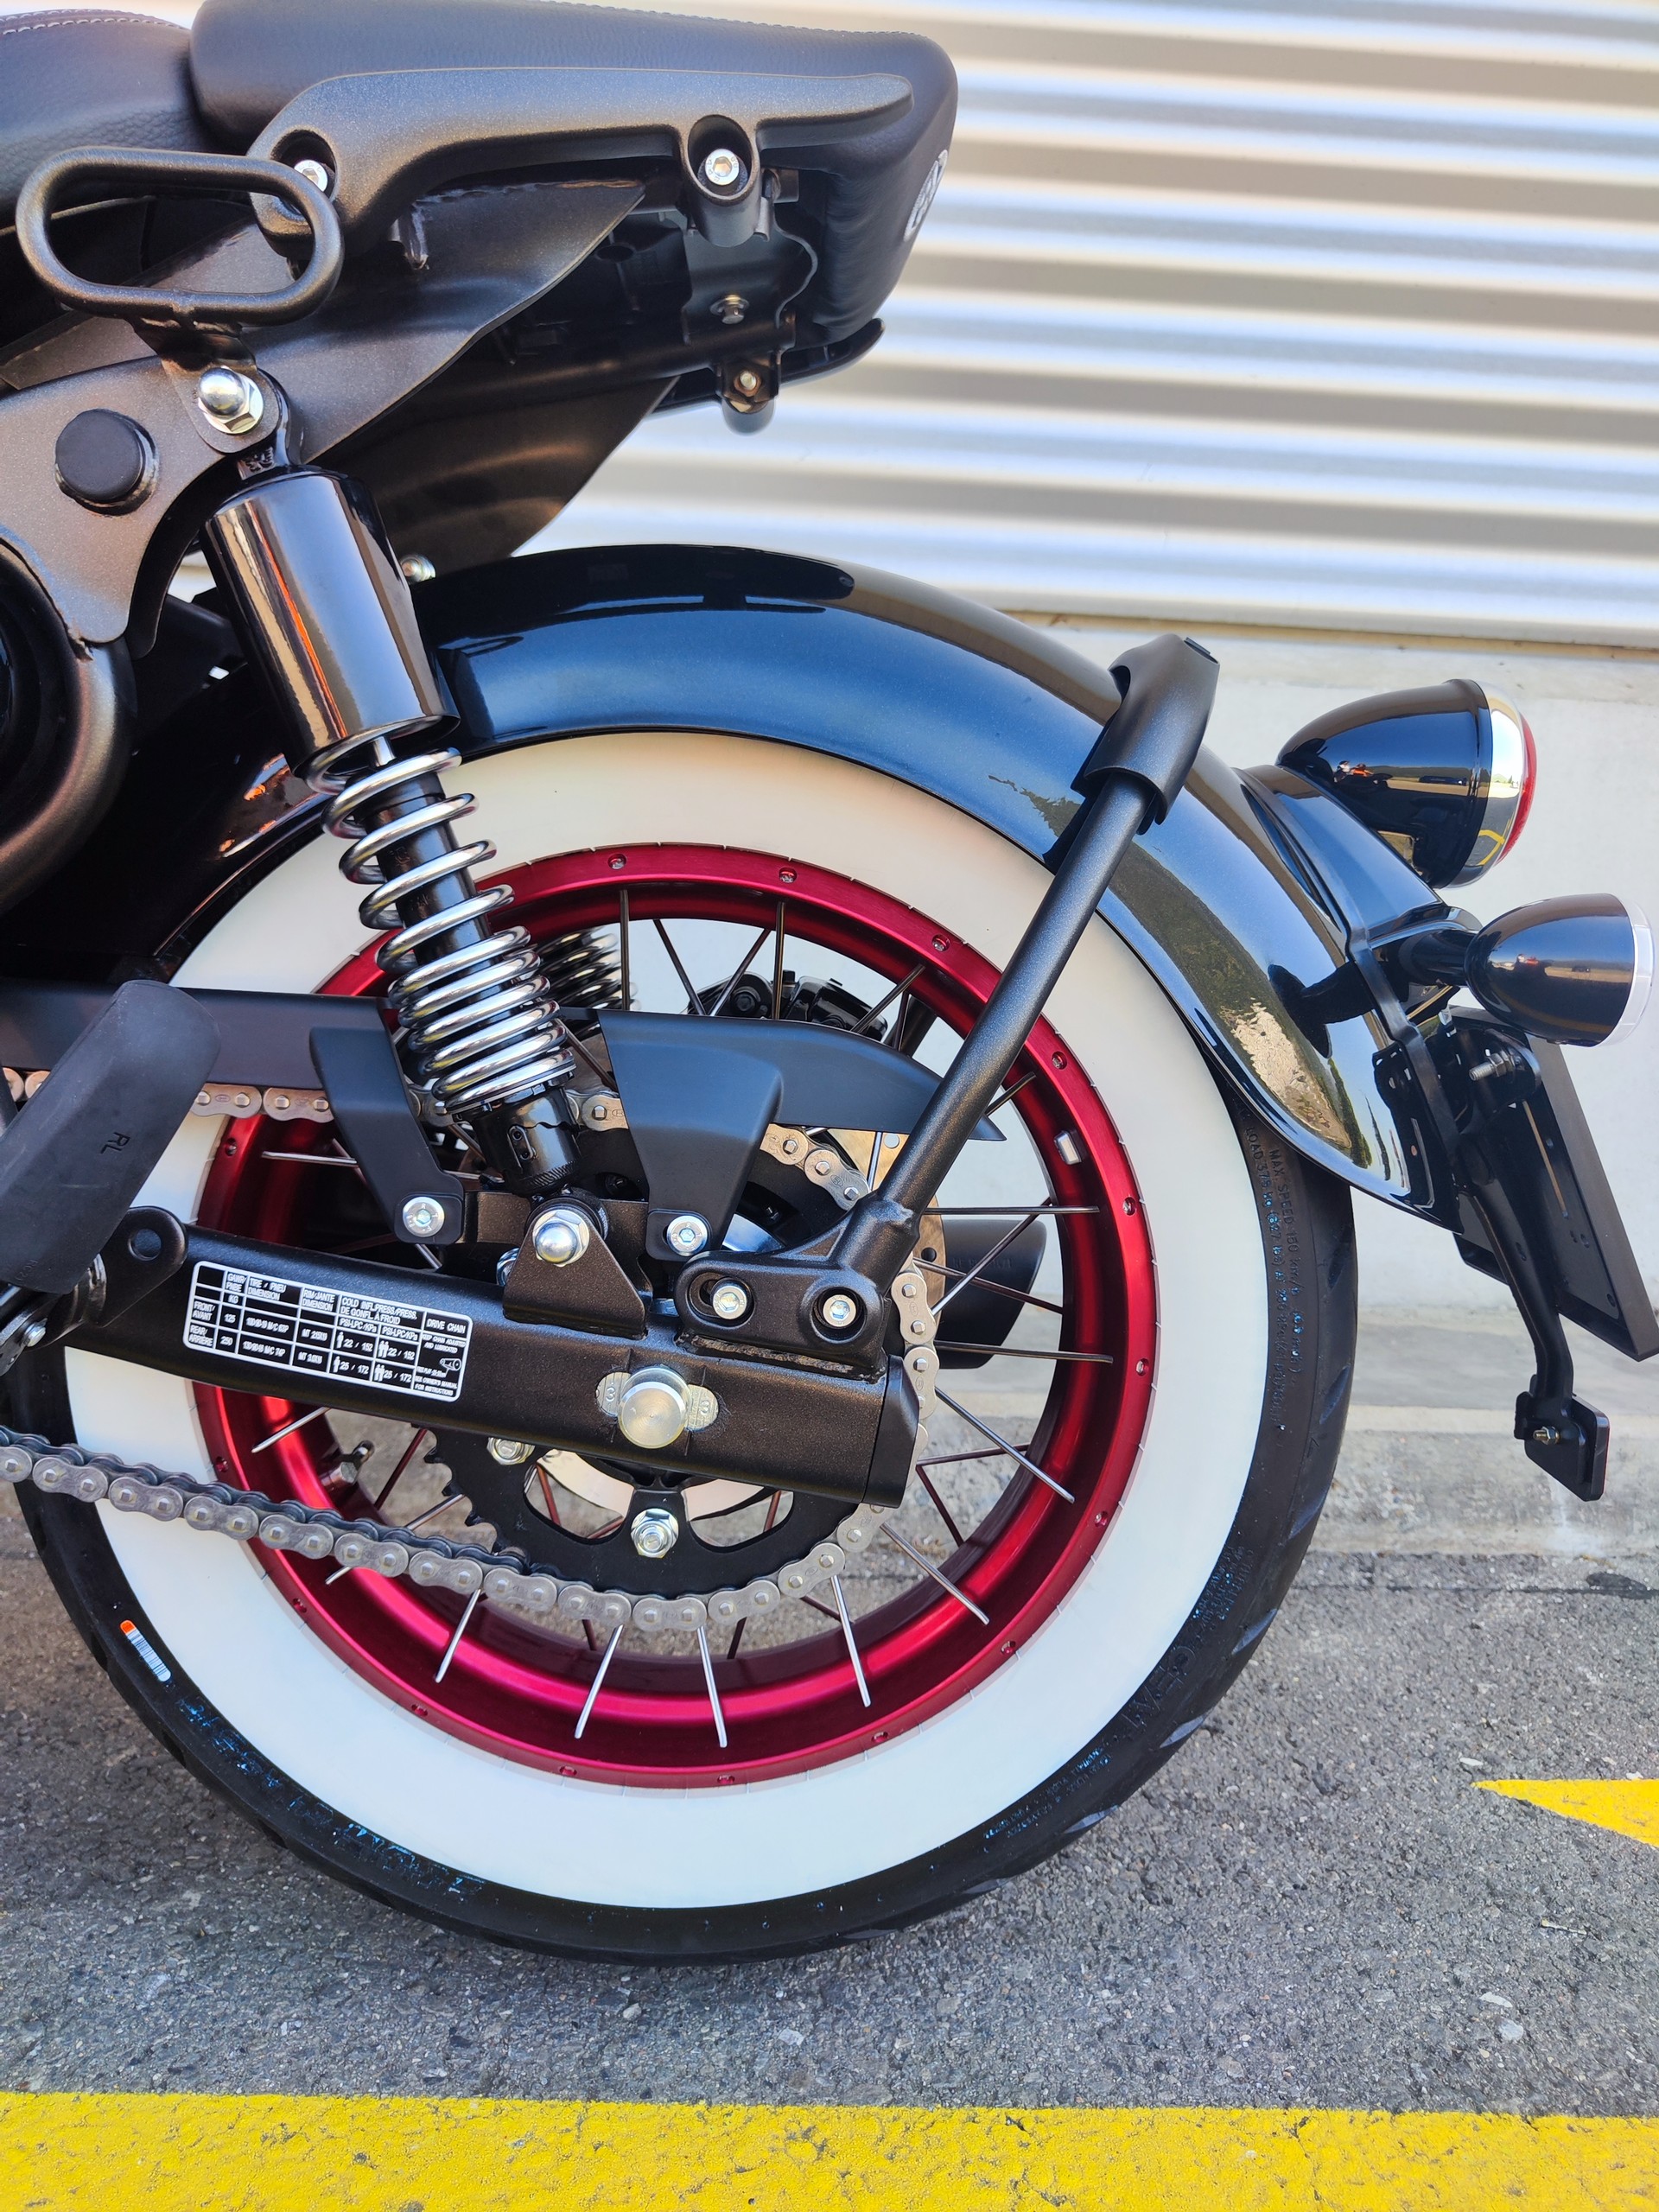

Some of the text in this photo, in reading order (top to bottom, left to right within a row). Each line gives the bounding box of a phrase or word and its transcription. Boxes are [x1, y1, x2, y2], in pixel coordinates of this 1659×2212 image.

[99, 1132, 130, 1154] RL
[1245, 1127, 1263, 1160] LOAD
[1278, 1184, 1294, 1224] SPEED
[250, 1278, 263, 1287] TIRE
[269, 1282, 287, 1293] PNEU
[228, 1294, 238, 1304] KG
[248, 1287, 281, 1301] DIMENSION
[303, 1289, 335, 1303] RIM/JANTE
[194, 1300, 215, 1313] FRONT/
[302, 1299, 334, 1312] DIMENSION
[342, 1297, 359, 1307] COLD
[192, 1309, 213, 1322] AVANT
[224, 1313, 236, 1324] 125
[380, 1314, 401, 1325] FROID
[190, 1325, 208, 1336] REAR/
[426, 1319, 466, 1334] DRIVE CHAIN
[219, 1336, 233, 1346] 250
[343, 1338, 353, 1348] 22
[361, 1343, 373, 1352] 152
[387, 1347, 397, 1357] 22
[404, 1351, 415, 1360] 152
[339, 1361, 349, 1370] 25
[357, 1364, 369, 1375] 172
[384, 1370, 392, 1379] 25
[400, 1373, 412, 1382] 172
[606, 1386, 615, 1402] 3
[699, 1401, 710, 1416] 3
